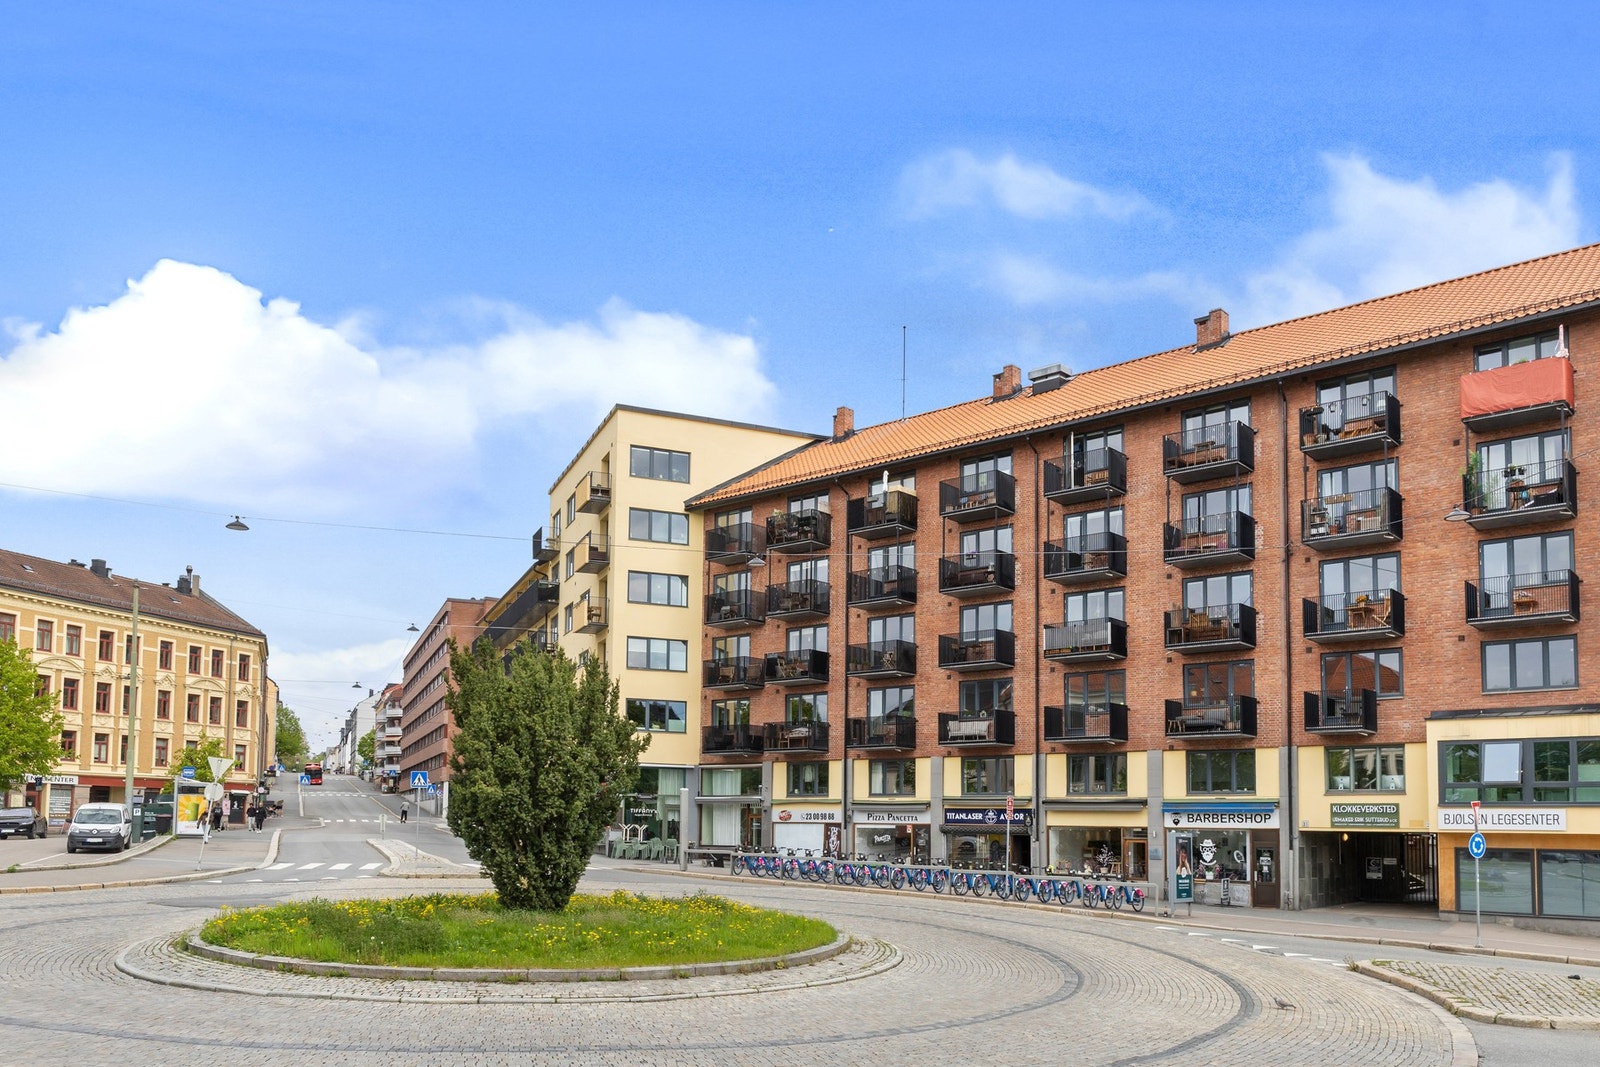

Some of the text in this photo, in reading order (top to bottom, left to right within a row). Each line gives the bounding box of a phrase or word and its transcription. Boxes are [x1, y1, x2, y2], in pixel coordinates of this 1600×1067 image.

[1332, 805, 1397, 813] KLOKKEVERKSTED
[1187, 813, 1271, 823] BARBERSHOP
[1491, 813, 1560, 826] LEGESENTER
